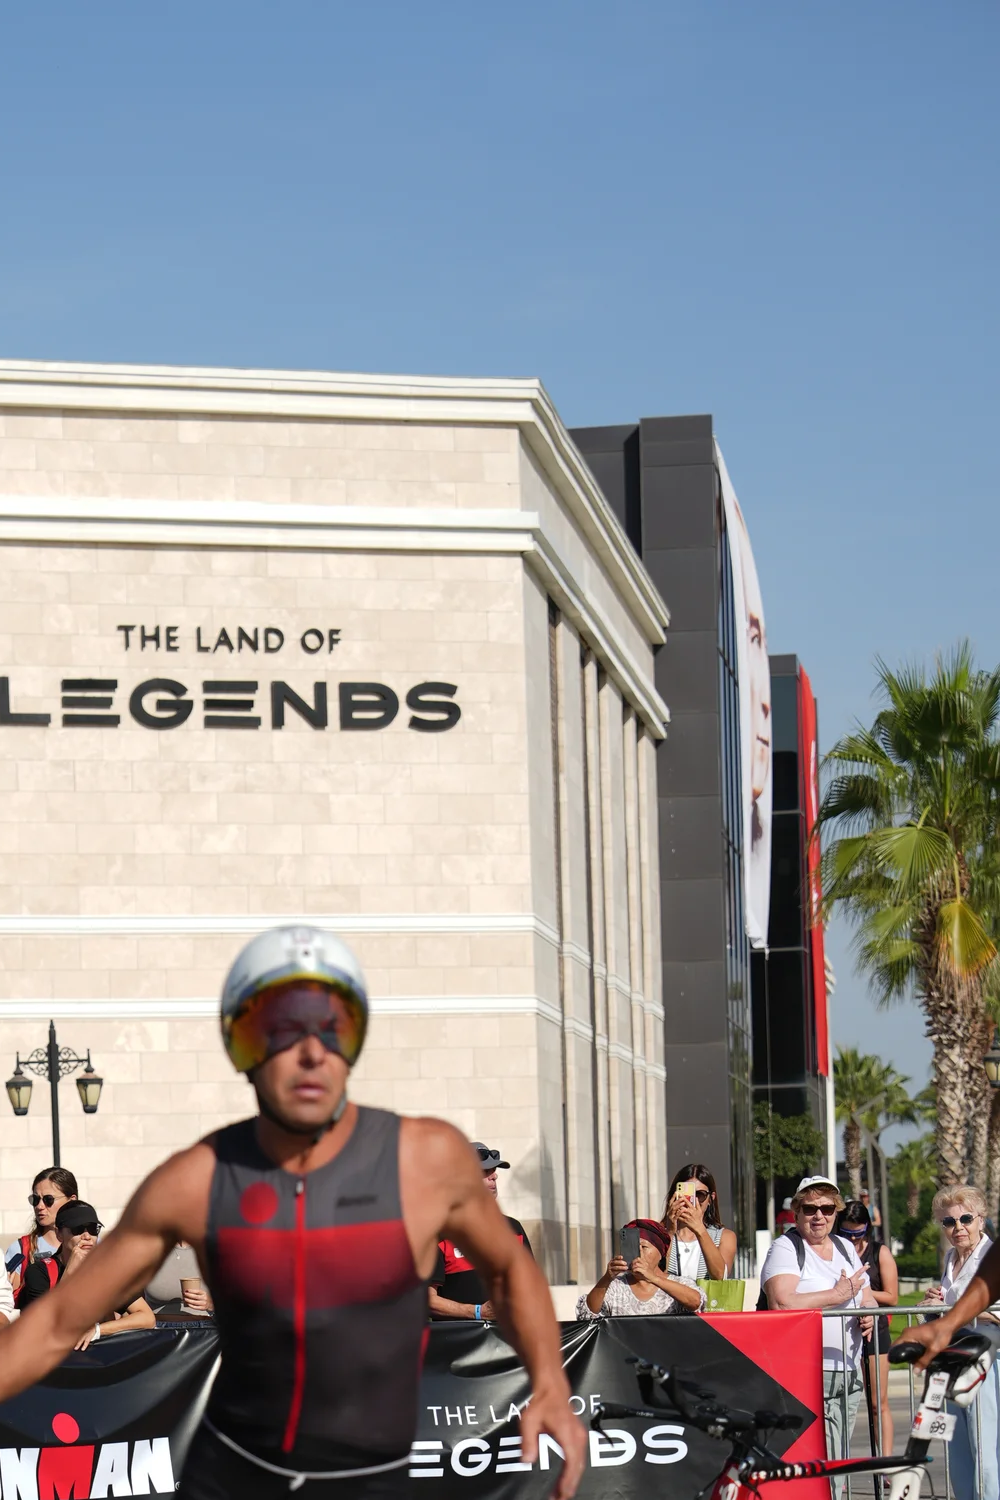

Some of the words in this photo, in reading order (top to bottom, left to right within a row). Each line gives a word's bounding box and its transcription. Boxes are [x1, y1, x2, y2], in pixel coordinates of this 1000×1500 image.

[117, 625, 180, 652] THE
[196, 626, 285, 654] LAND
[301, 628, 342, 654] OF
[427, 1405, 479, 1426] THE
[489, 1400, 530, 1423] LA
[568, 1394, 601, 1416] OF
